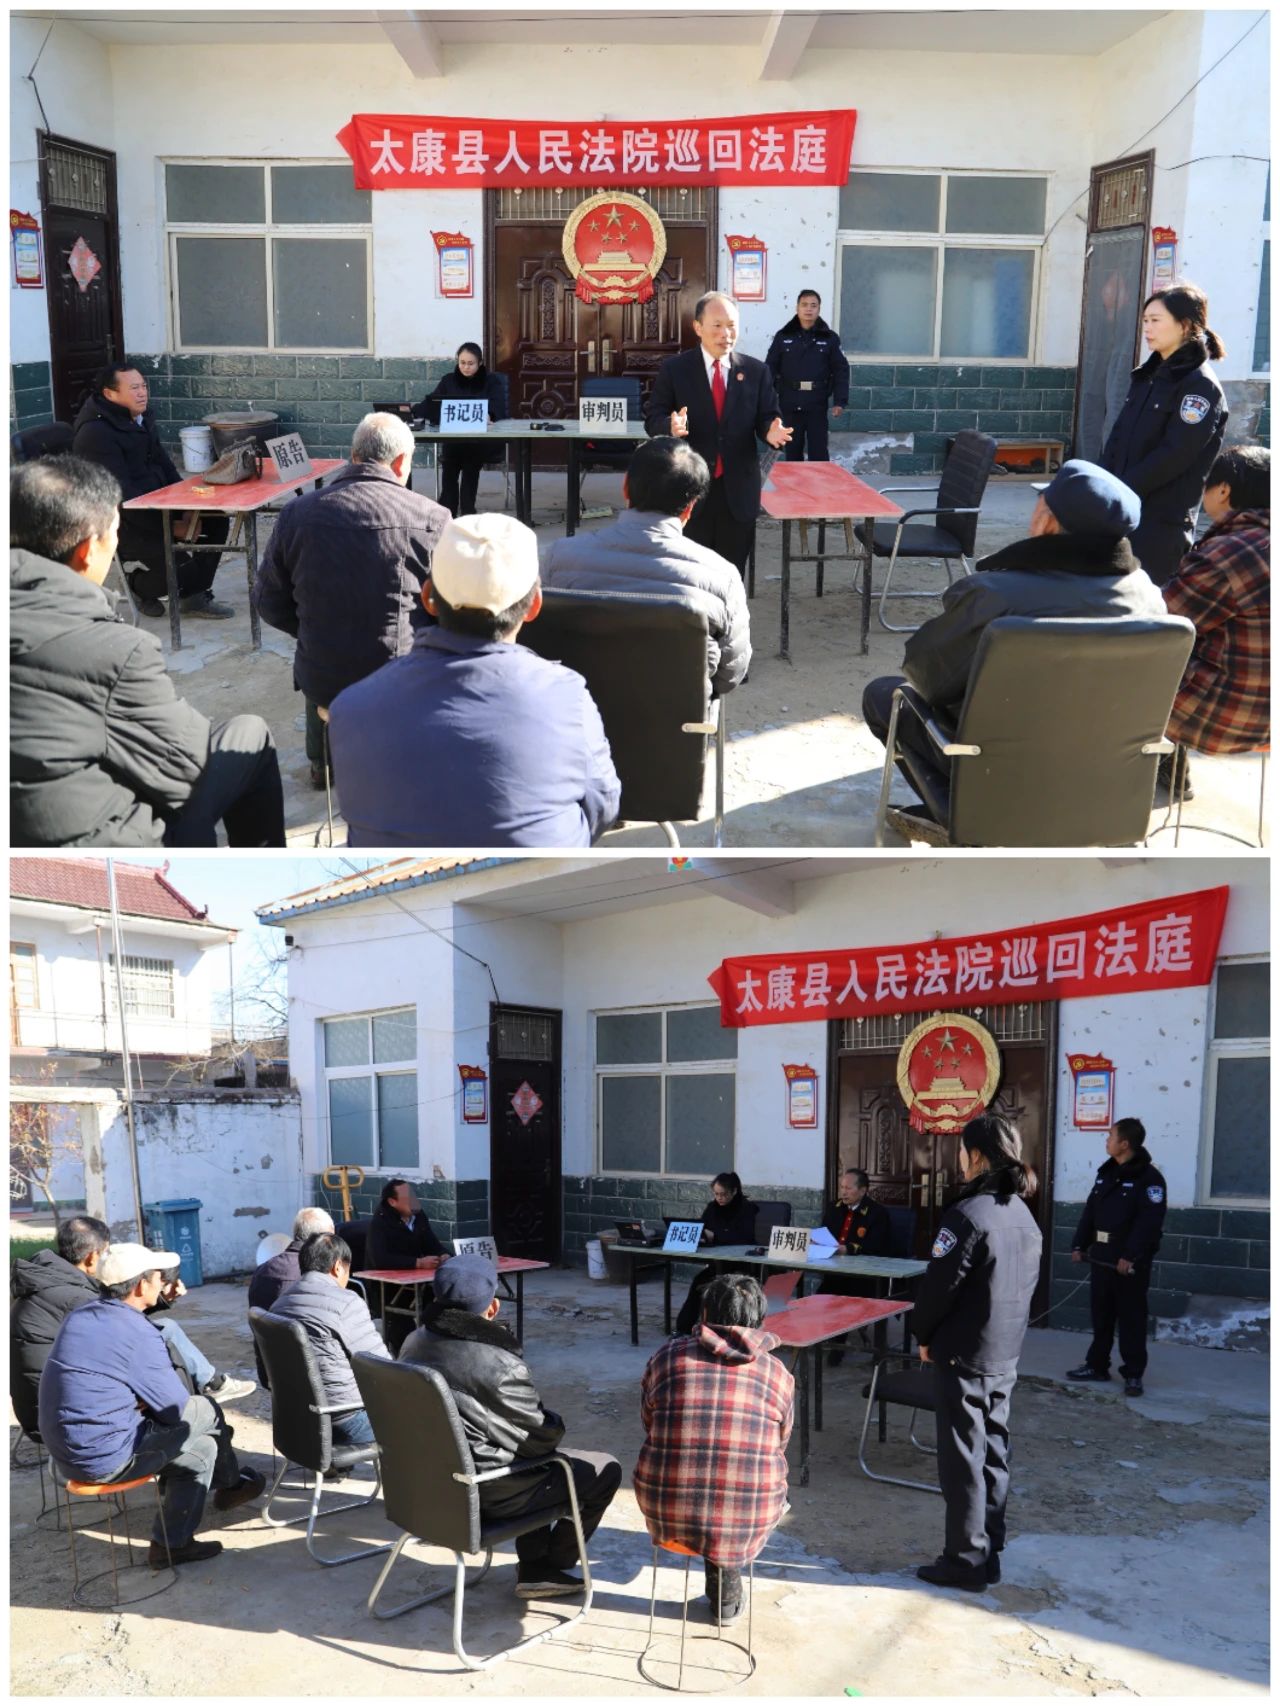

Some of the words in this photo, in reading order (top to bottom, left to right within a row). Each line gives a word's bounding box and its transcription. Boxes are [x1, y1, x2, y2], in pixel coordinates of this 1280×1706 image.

[370, 125, 828, 175] 太康县人民法院巡回法庭
[443, 403, 484, 423] 书记员
[582, 401, 623, 423] 审判员
[272, 438, 305, 469] 原告
[735, 912, 1194, 1014] 太康县人民法院巡回法庭
[669, 1224, 700, 1243] 书记员
[772, 1228, 808, 1252] 审判员
